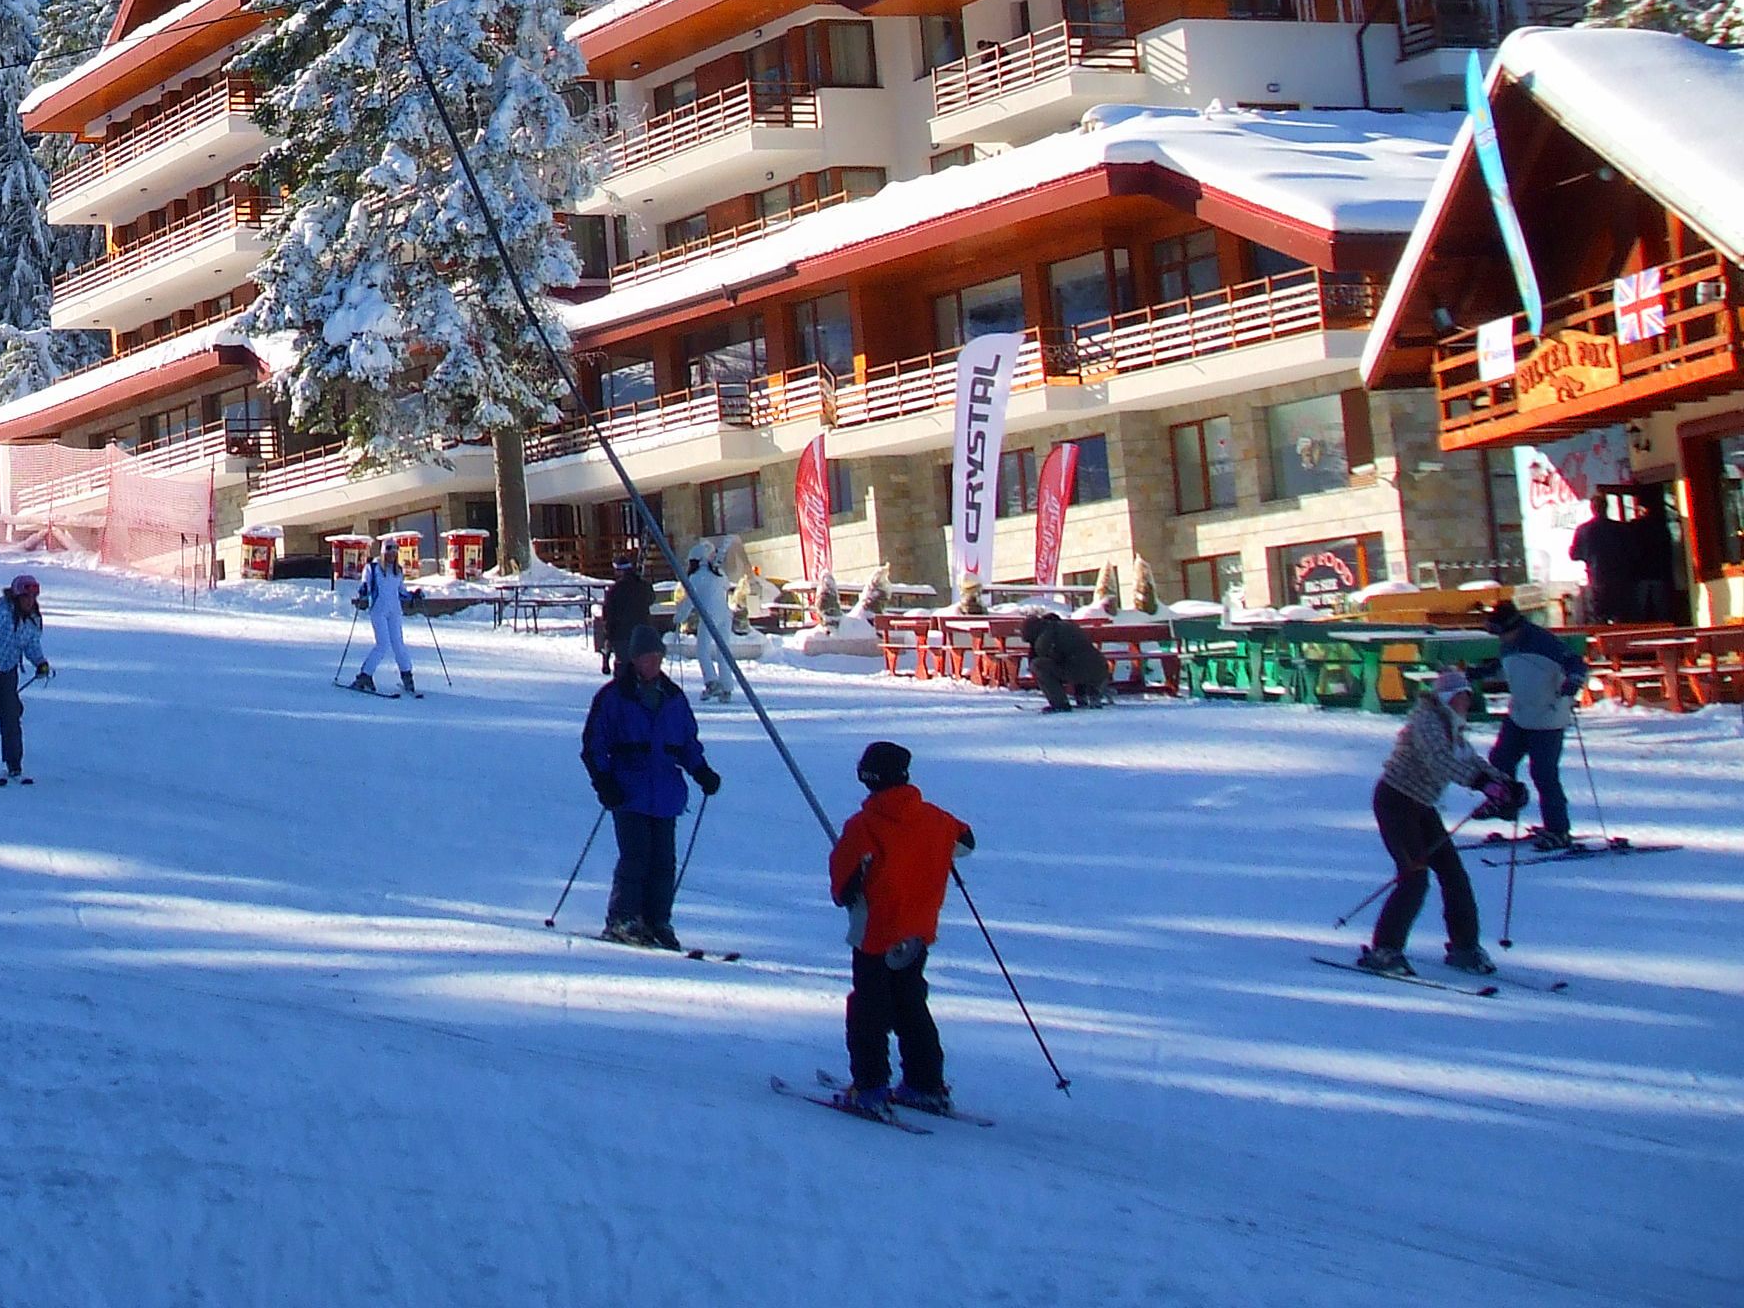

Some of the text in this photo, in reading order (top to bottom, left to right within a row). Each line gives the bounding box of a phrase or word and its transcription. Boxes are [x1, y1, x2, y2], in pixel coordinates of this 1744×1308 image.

[1520, 341, 1612, 394] SILVER FOX
[965, 354, 1001, 543] CRYSTAL
